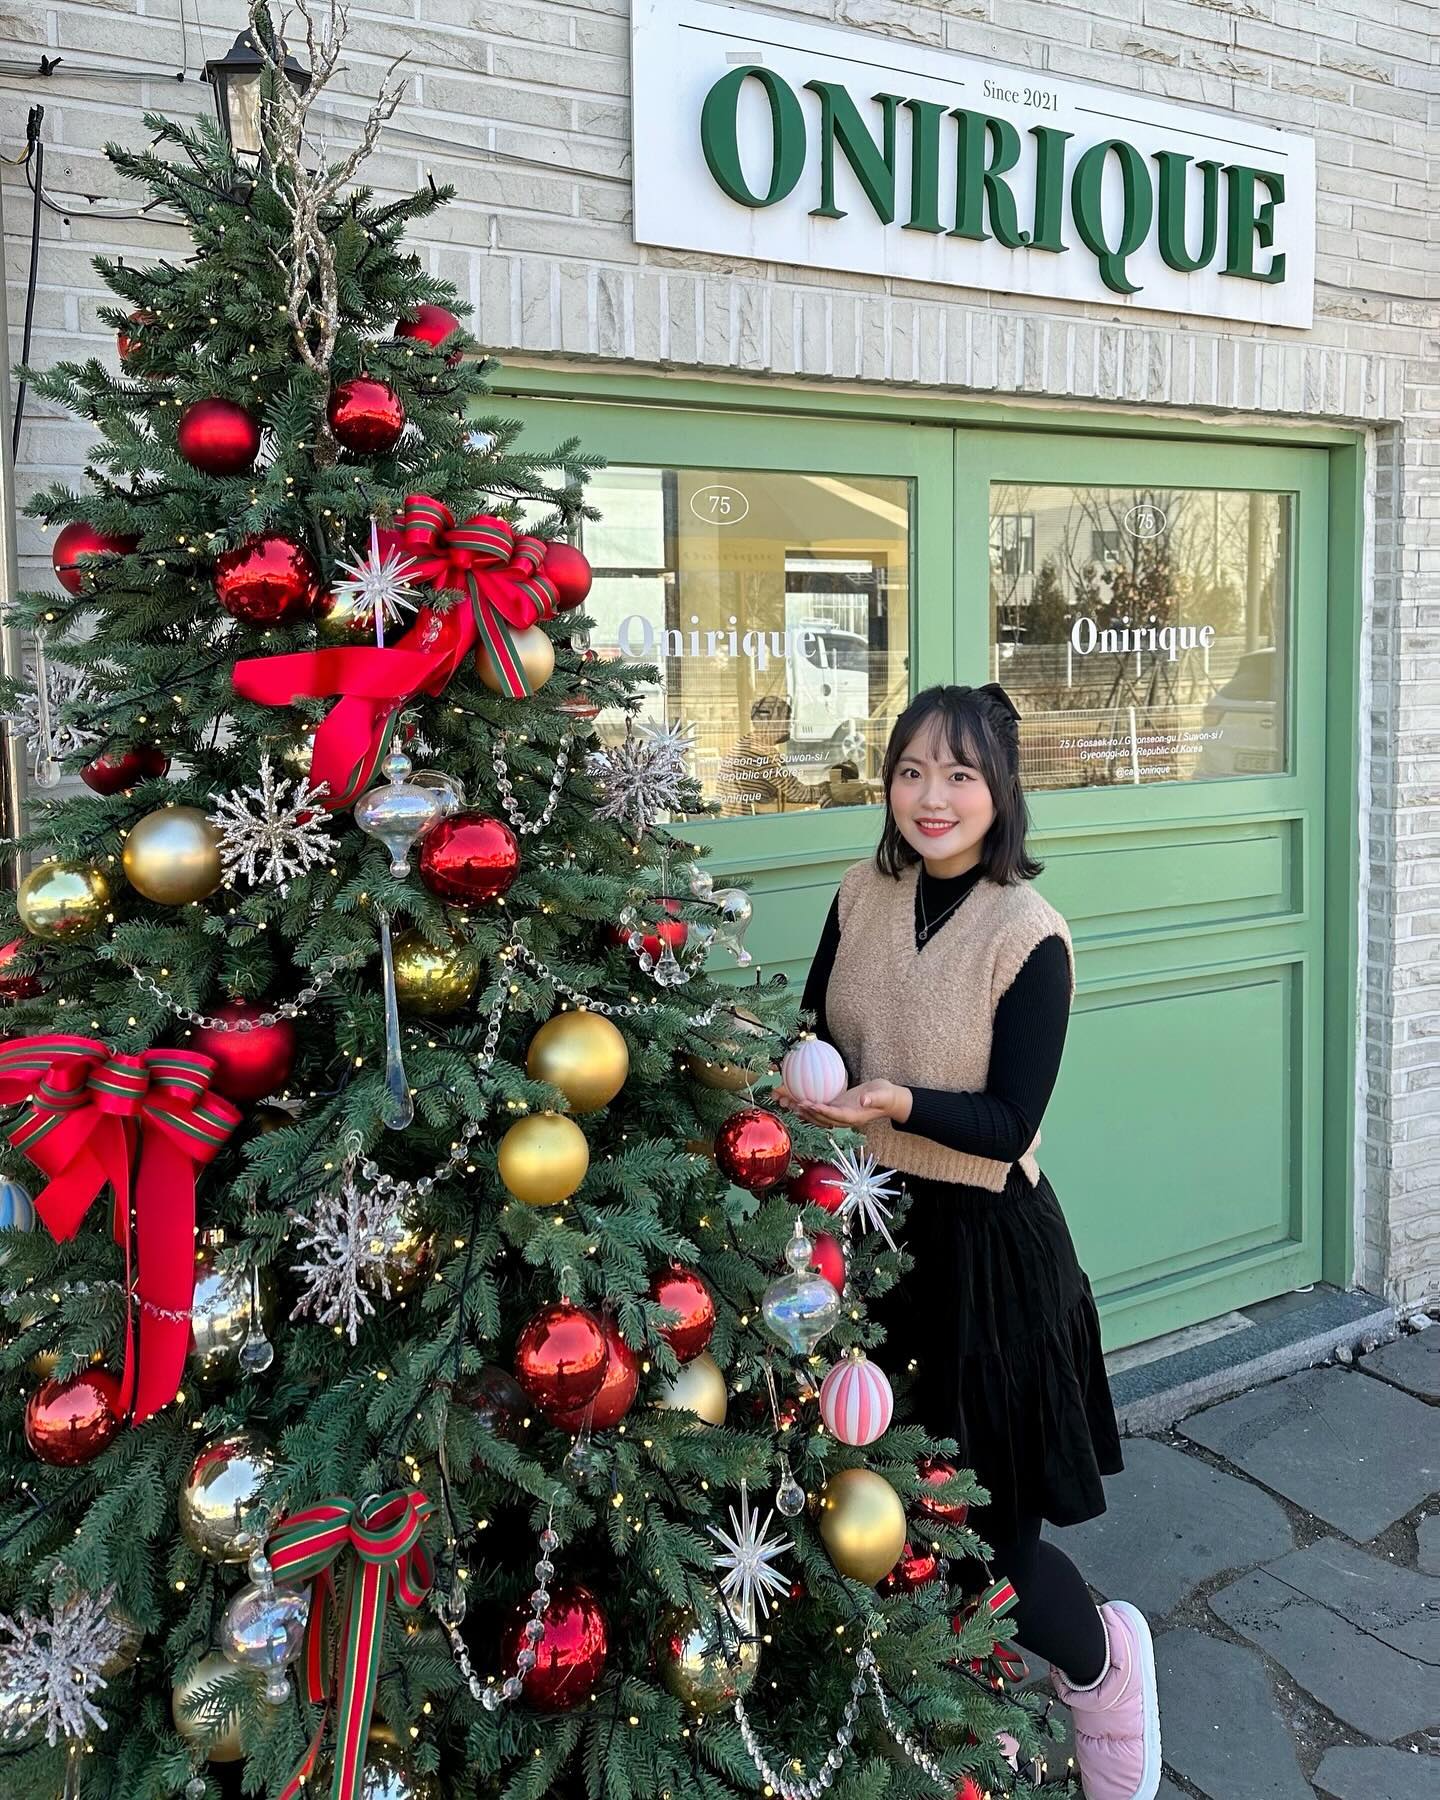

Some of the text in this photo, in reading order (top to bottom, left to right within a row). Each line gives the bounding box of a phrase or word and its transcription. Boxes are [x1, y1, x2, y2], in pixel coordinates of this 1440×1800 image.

[983, 79, 1058, 112] Since 2021
[701, 65, 1285, 295] ONIRIQUE
[709, 495, 731, 515] 75
[1137, 513, 1154, 530] 75
[618, 614, 817, 672] Onirique
[1071, 614, 1216, 662] Onirique
[1059, 739, 1070, 749] 75
[1076, 737, 1118, 748] Gosaek-ro
[1183, 730, 1218, 742] Suwon-si
[779, 751, 823, 764] Suwon-si
[1080, 748, 1129, 762] Gyeonggi-do
[1137, 746, 1169, 758] Republic
[1181, 744, 1203, 754] Korea
[762, 768, 774, 779] of
[775, 766, 804, 778] Korea
